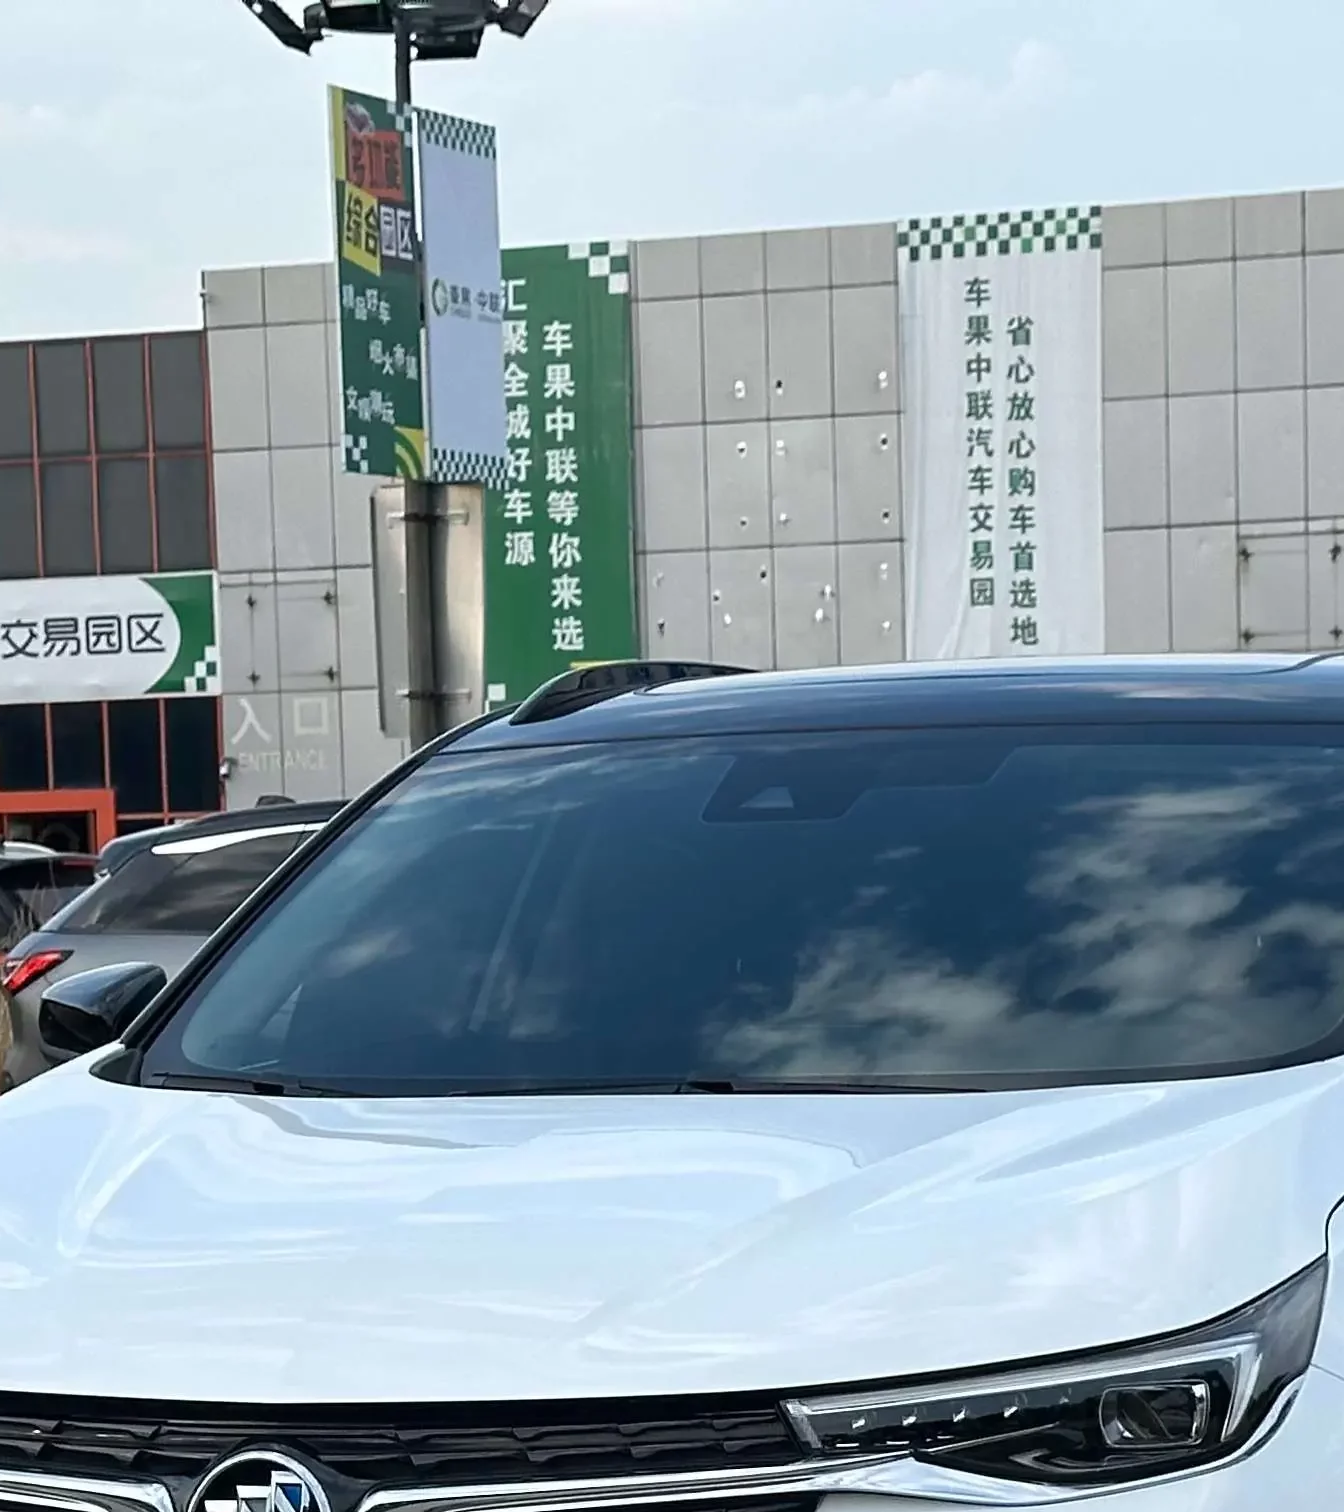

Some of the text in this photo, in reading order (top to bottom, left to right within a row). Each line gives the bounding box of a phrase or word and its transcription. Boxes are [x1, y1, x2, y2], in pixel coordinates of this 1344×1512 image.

[542, 320, 584, 652] 车果中联等你来选
[963, 277, 996, 608] 车果中联汽车交易园
[1006, 315, 1040, 646] 省心放心购车首选地
[230, 696, 329, 745] 入口
[239, 749, 328, 773] ENTRANCE
